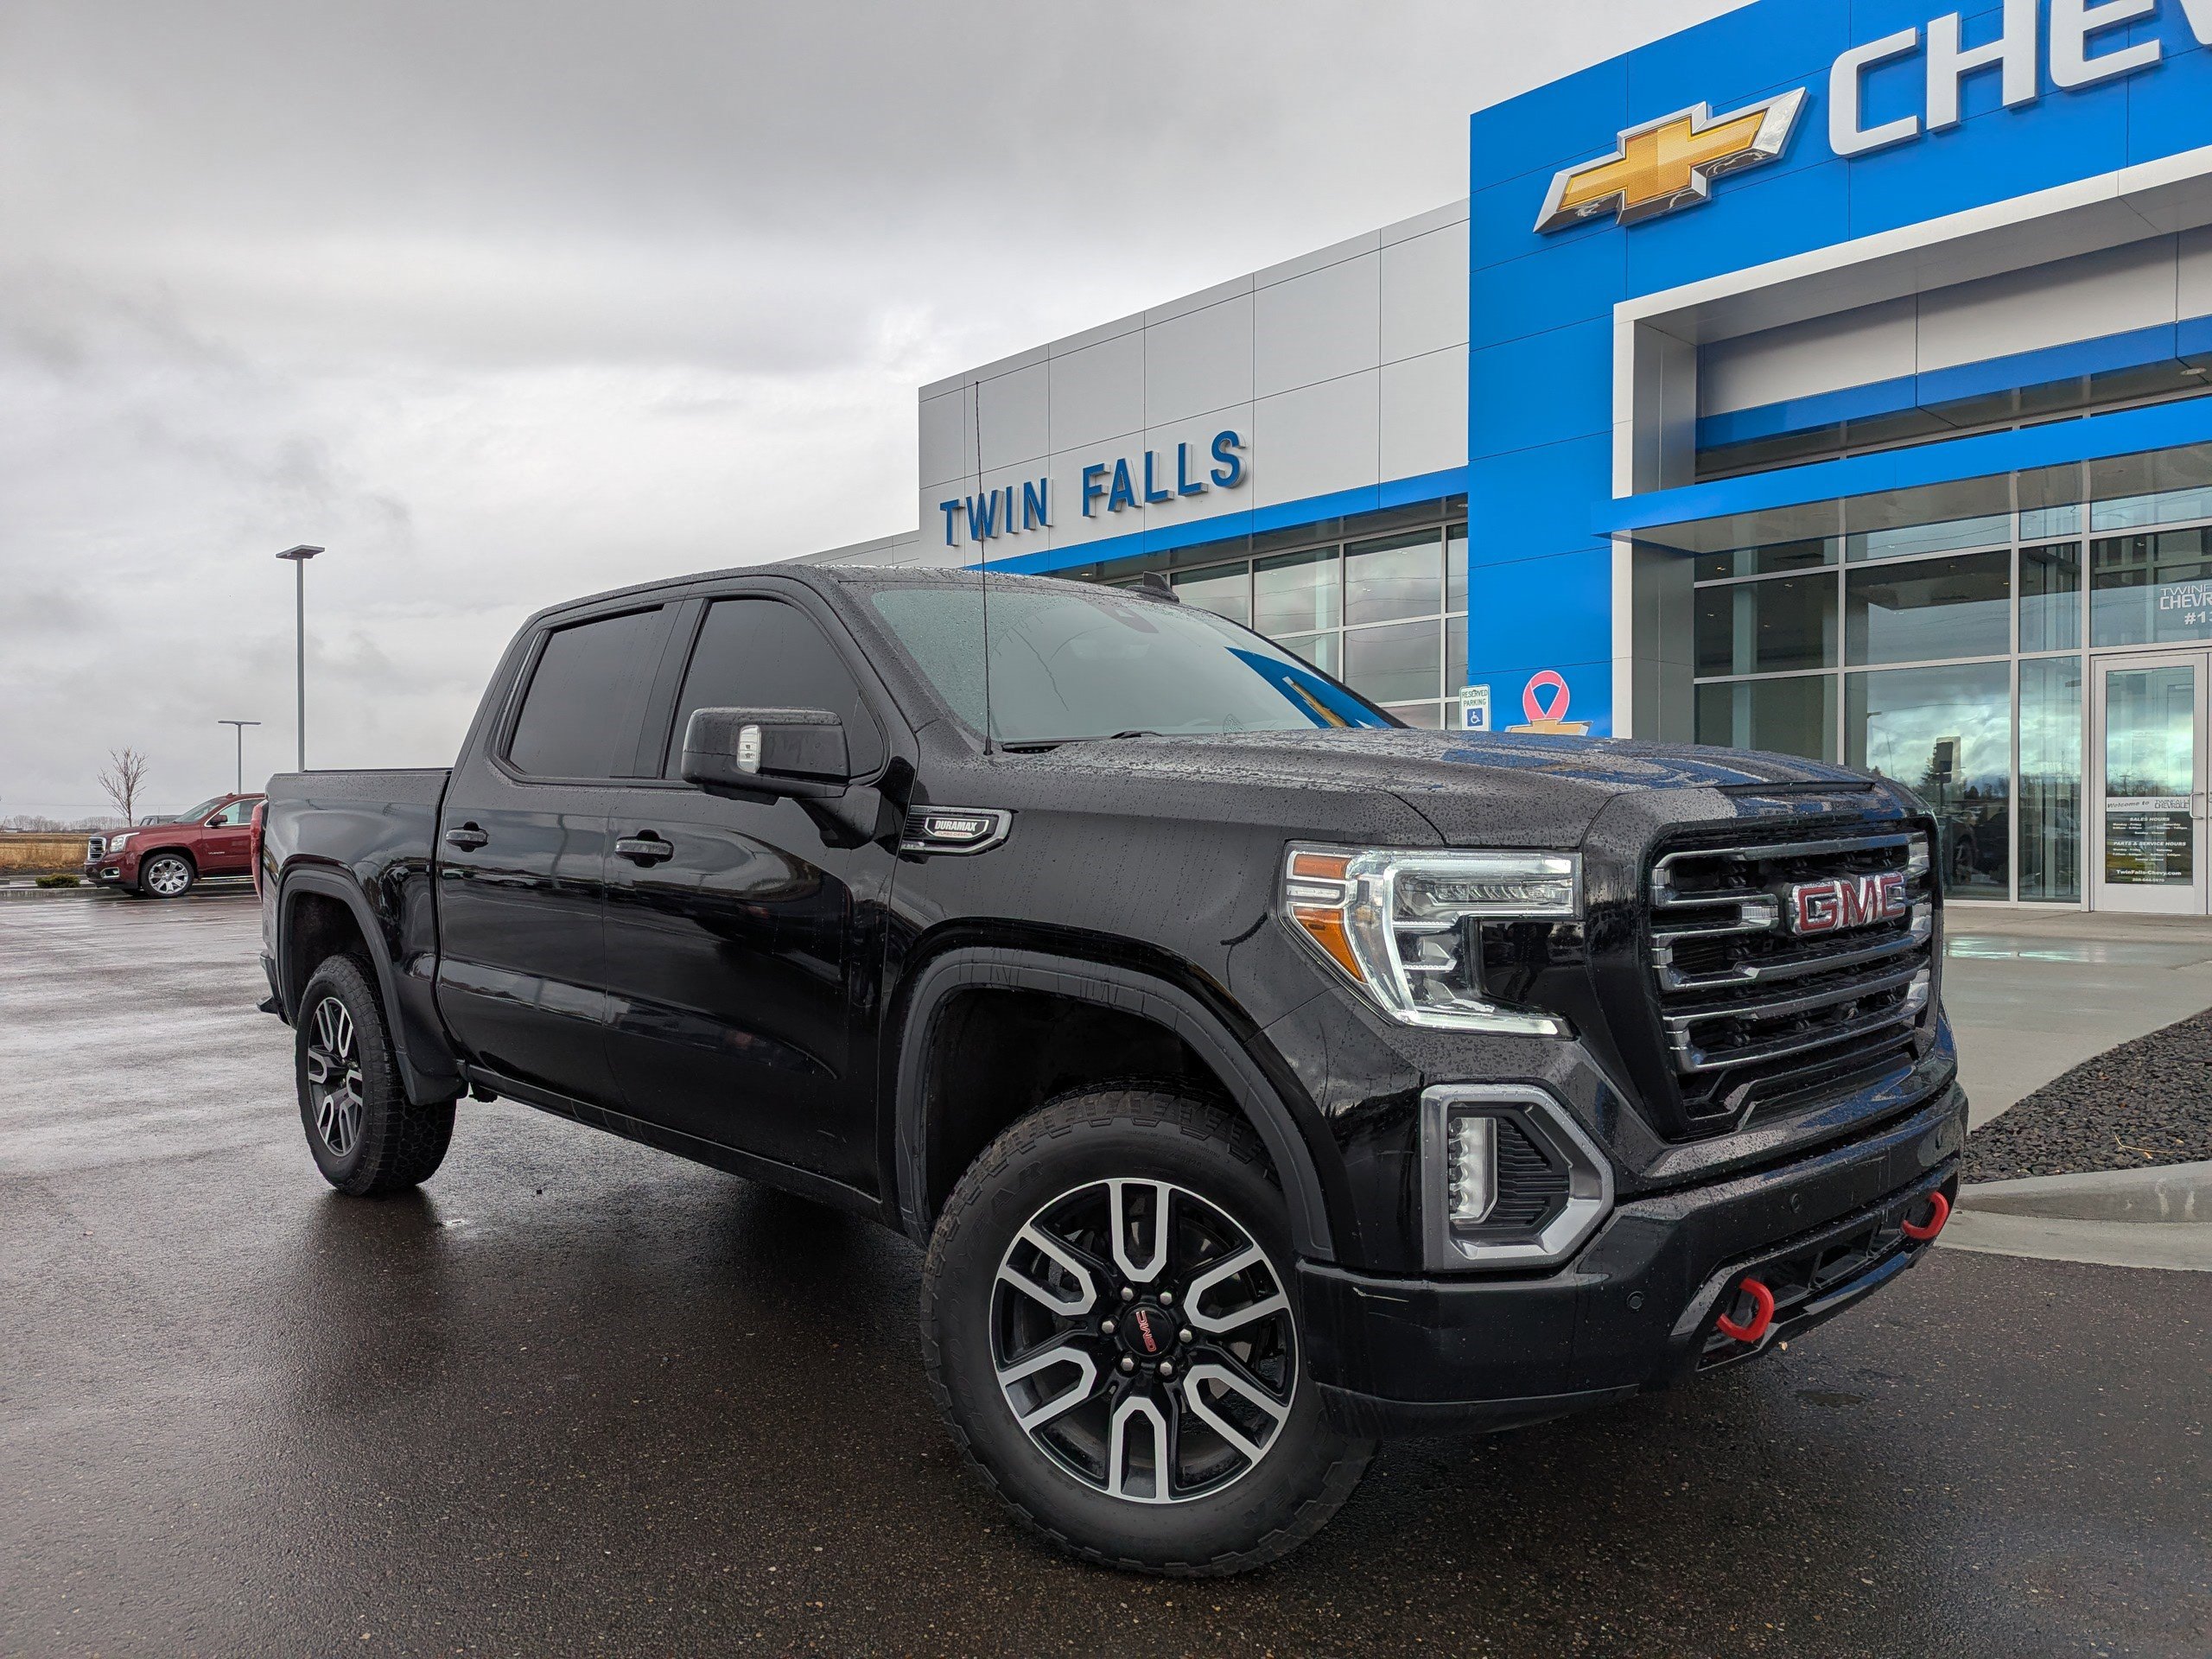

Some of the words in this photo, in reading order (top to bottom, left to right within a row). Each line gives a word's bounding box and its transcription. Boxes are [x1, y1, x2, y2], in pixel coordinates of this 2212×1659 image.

[939, 477, 1053, 547] TWIN
[1082, 430, 1247, 518] FALLS
[1461, 689, 1488, 698] RESERVED
[1463, 698, 1487, 707] PARKING
[934, 820, 977, 832] DURAMAX
[1791, 872, 1906, 936] GMC
[1135, 1310, 1157, 1353] GMC
